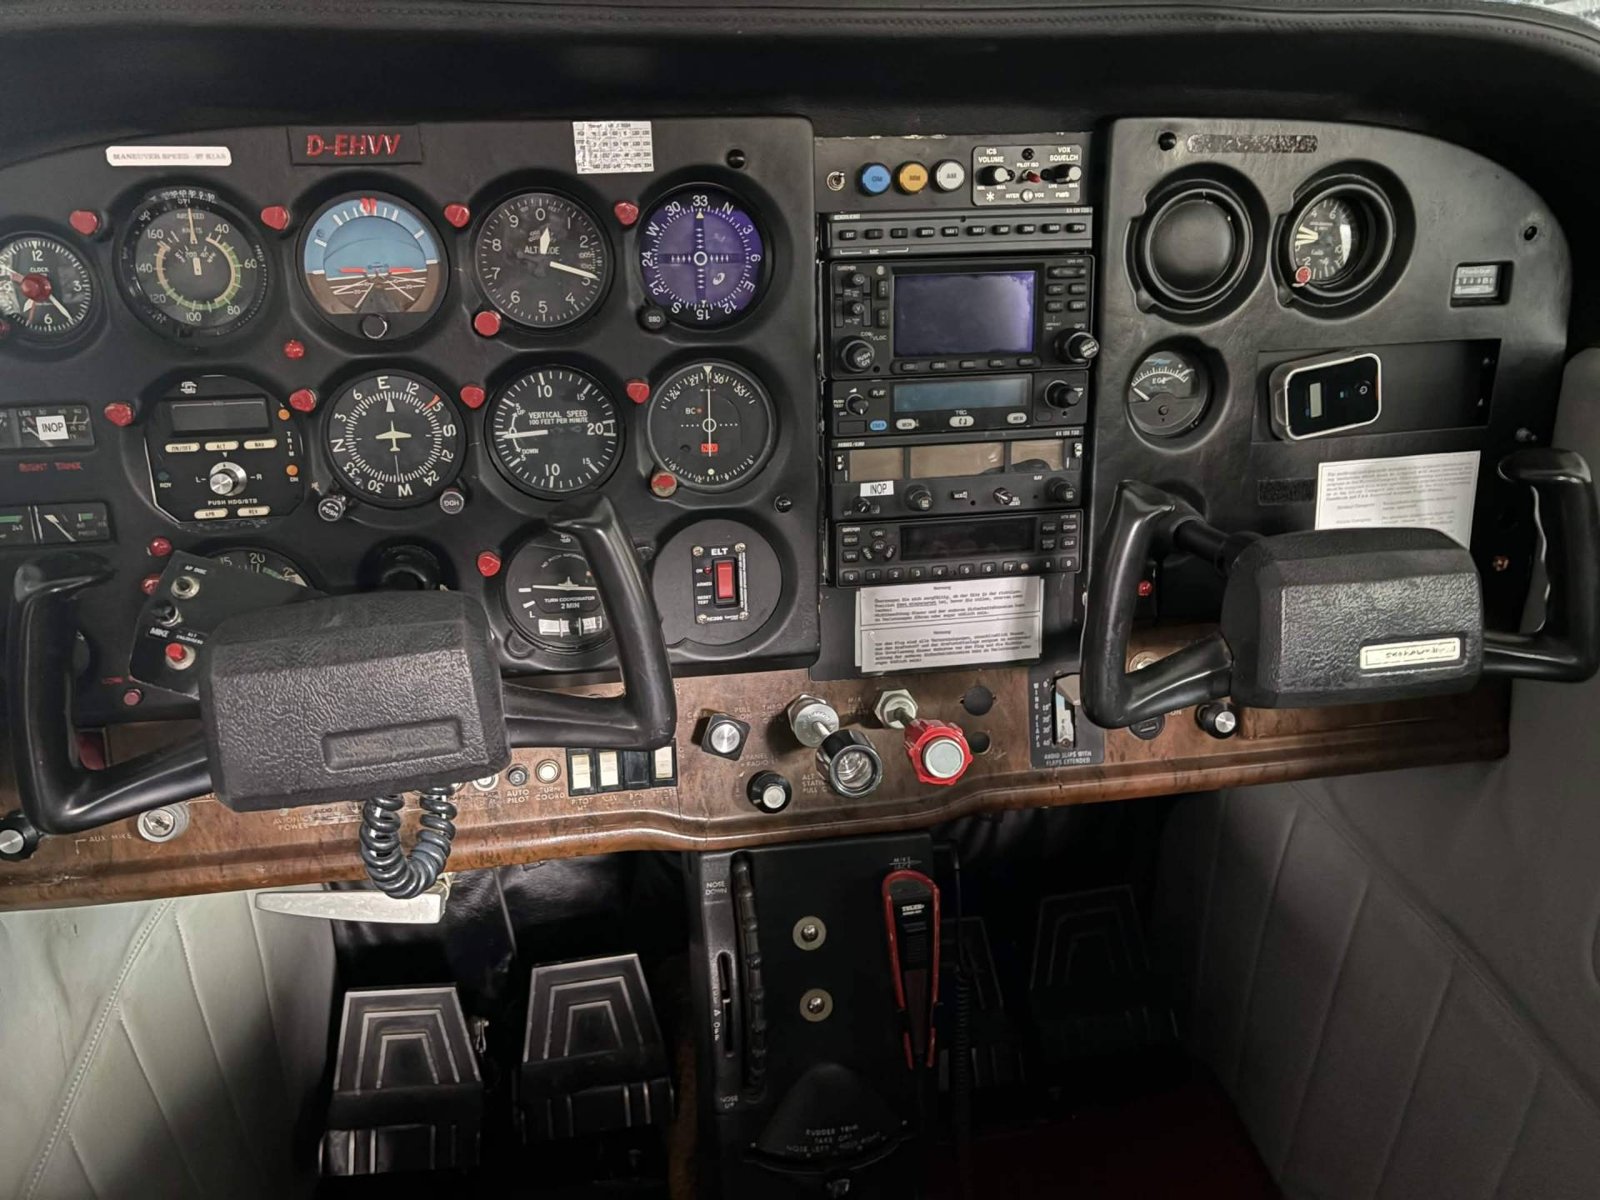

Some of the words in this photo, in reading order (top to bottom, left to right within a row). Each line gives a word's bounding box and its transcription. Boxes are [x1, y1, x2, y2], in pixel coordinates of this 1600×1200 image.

[306, 134, 401, 156] D-EHVV
[692, 195, 708, 207] 33
[535, 207, 546, 221] 0
[665, 201, 681, 216] 30
[722, 202, 734, 215] N
[508, 214, 519, 228] 9
[147, 229, 163, 239] 160
[215, 224, 229, 233] 40
[645, 221, 660, 237] W
[742, 225, 754, 234] 3
[491, 239, 502, 252] 8
[580, 235, 589, 248] 2
[32, 250, 43, 262] 12
[641, 251, 654, 267] 24
[136, 264, 153, 273] 140
[245, 258, 257, 269] 60
[491, 267, 501, 280] 7
[73, 280, 82, 292] 3
[649, 280, 664, 295] 21
[743, 281, 756, 292] E
[150, 294, 166, 303] 120
[510, 291, 520, 304] 6
[565, 292, 576, 305] 4
[228, 306, 240, 315] 80
[538, 301, 548, 313] 5
[671, 302, 682, 314] S
[723, 300, 737, 314] 12
[44, 313, 52, 325] 6
[186, 312, 202, 322] 100
[696, 309, 710, 320] 15
[377, 376, 391, 390] E
[713, 375, 724, 385] 30
[353, 389, 362, 400] 6
[406, 381, 420, 396] 12
[538, 385, 553, 398] 10
[576, 393, 585, 401] 15
[516, 403, 521, 411] 5
[685, 407, 696, 415] BC
[334, 413, 347, 422] 3
[41, 423, 64, 433] INOP
[443, 424, 456, 437] S
[587, 423, 604, 436] 20
[330, 438, 346, 453] N
[440, 449, 454, 463] 21
[343, 462, 360, 479] 33
[545, 464, 561, 476] 10
[424, 470, 440, 487] 24
[367, 480, 385, 494] 30
[397, 483, 413, 497] W
[869, 483, 887, 495] INOP
[321, 506, 339, 518] PUSH
[220, 556, 233, 566] 15
[249, 552, 265, 564] 20
[150, 628, 170, 638] MIKE
[507, 789, 529, 797] AUTO
[111, 833, 132, 841] MIKE
[705, 887, 727, 895] DOWN
[806, 1128, 835, 1136] RUDDER
